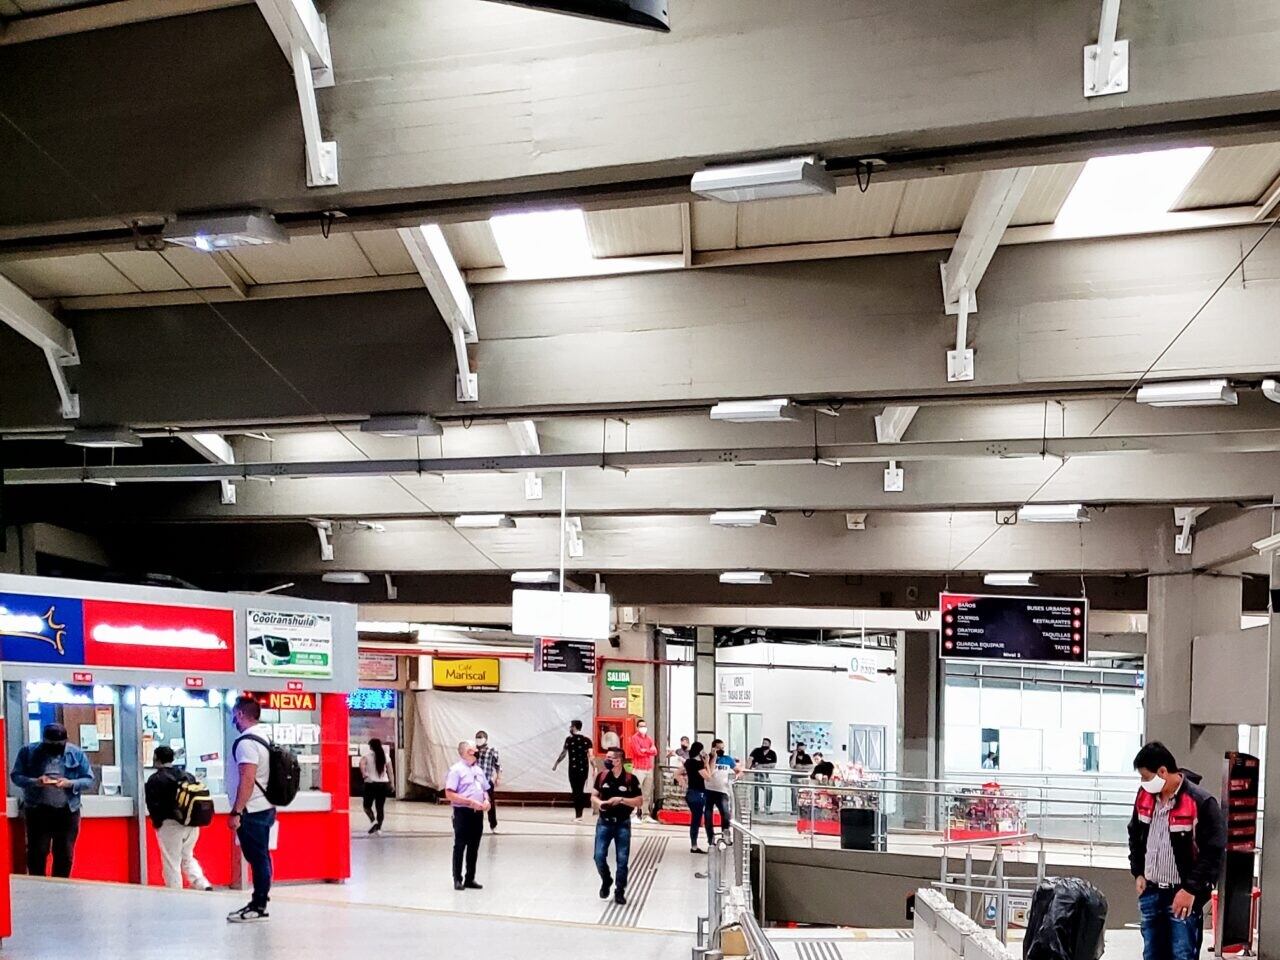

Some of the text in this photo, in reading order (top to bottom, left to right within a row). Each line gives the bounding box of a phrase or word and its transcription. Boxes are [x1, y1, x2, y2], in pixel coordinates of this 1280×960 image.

[445, 669, 486, 681] Mariscal
[607, 671, 630, 682] SALIDA
[270, 693, 312, 709] NEIVA
